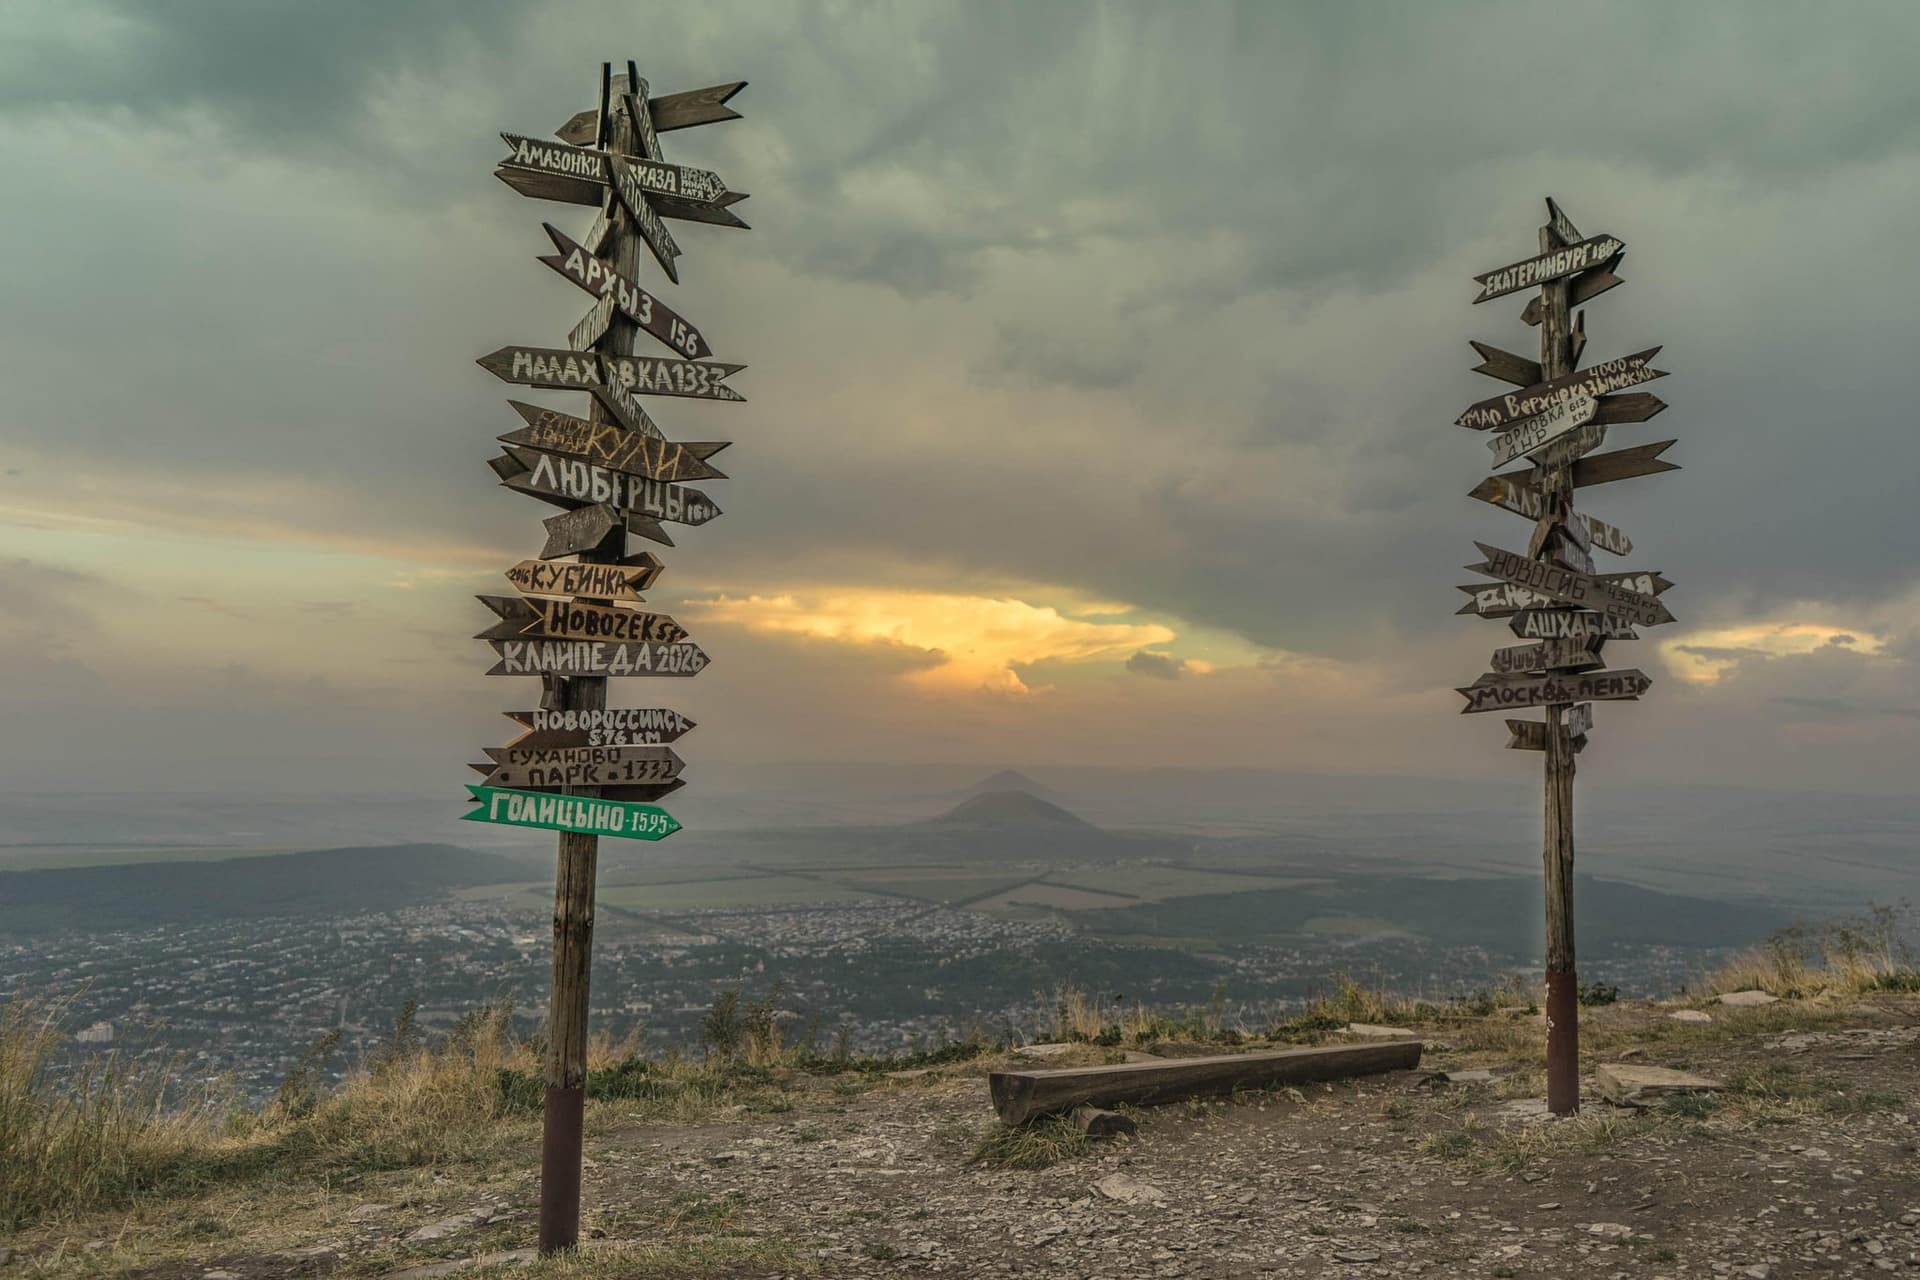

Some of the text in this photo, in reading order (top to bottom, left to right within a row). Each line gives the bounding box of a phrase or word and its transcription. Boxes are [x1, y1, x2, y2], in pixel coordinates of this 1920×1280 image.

[514, 140, 601, 178] АМАЗОНКИ
[1485, 243, 1592, 296] ЕКАТЕРИНБУРГ
[564, 249, 653, 324] АРХЫЗ
[670, 318, 698, 356] 156
[512, 352, 673, 391] МАЛАХВКА
[1589, 358, 1627, 377] 4000
[1496, 405, 1565, 452] ГОРЛОВКА
[1506, 428, 1548, 459] ДНР
[509, 565, 627, 594] 2016 КУБИНКА
[1524, 611, 1634, 639] АШХАБАД
[655, 645, 705, 673] 2026
[509, 748, 621, 765] СУХАНОВО
[529, 765, 600, 786] ПАРК
[490, 791, 625, 831] ГОЛИЦЫНО
